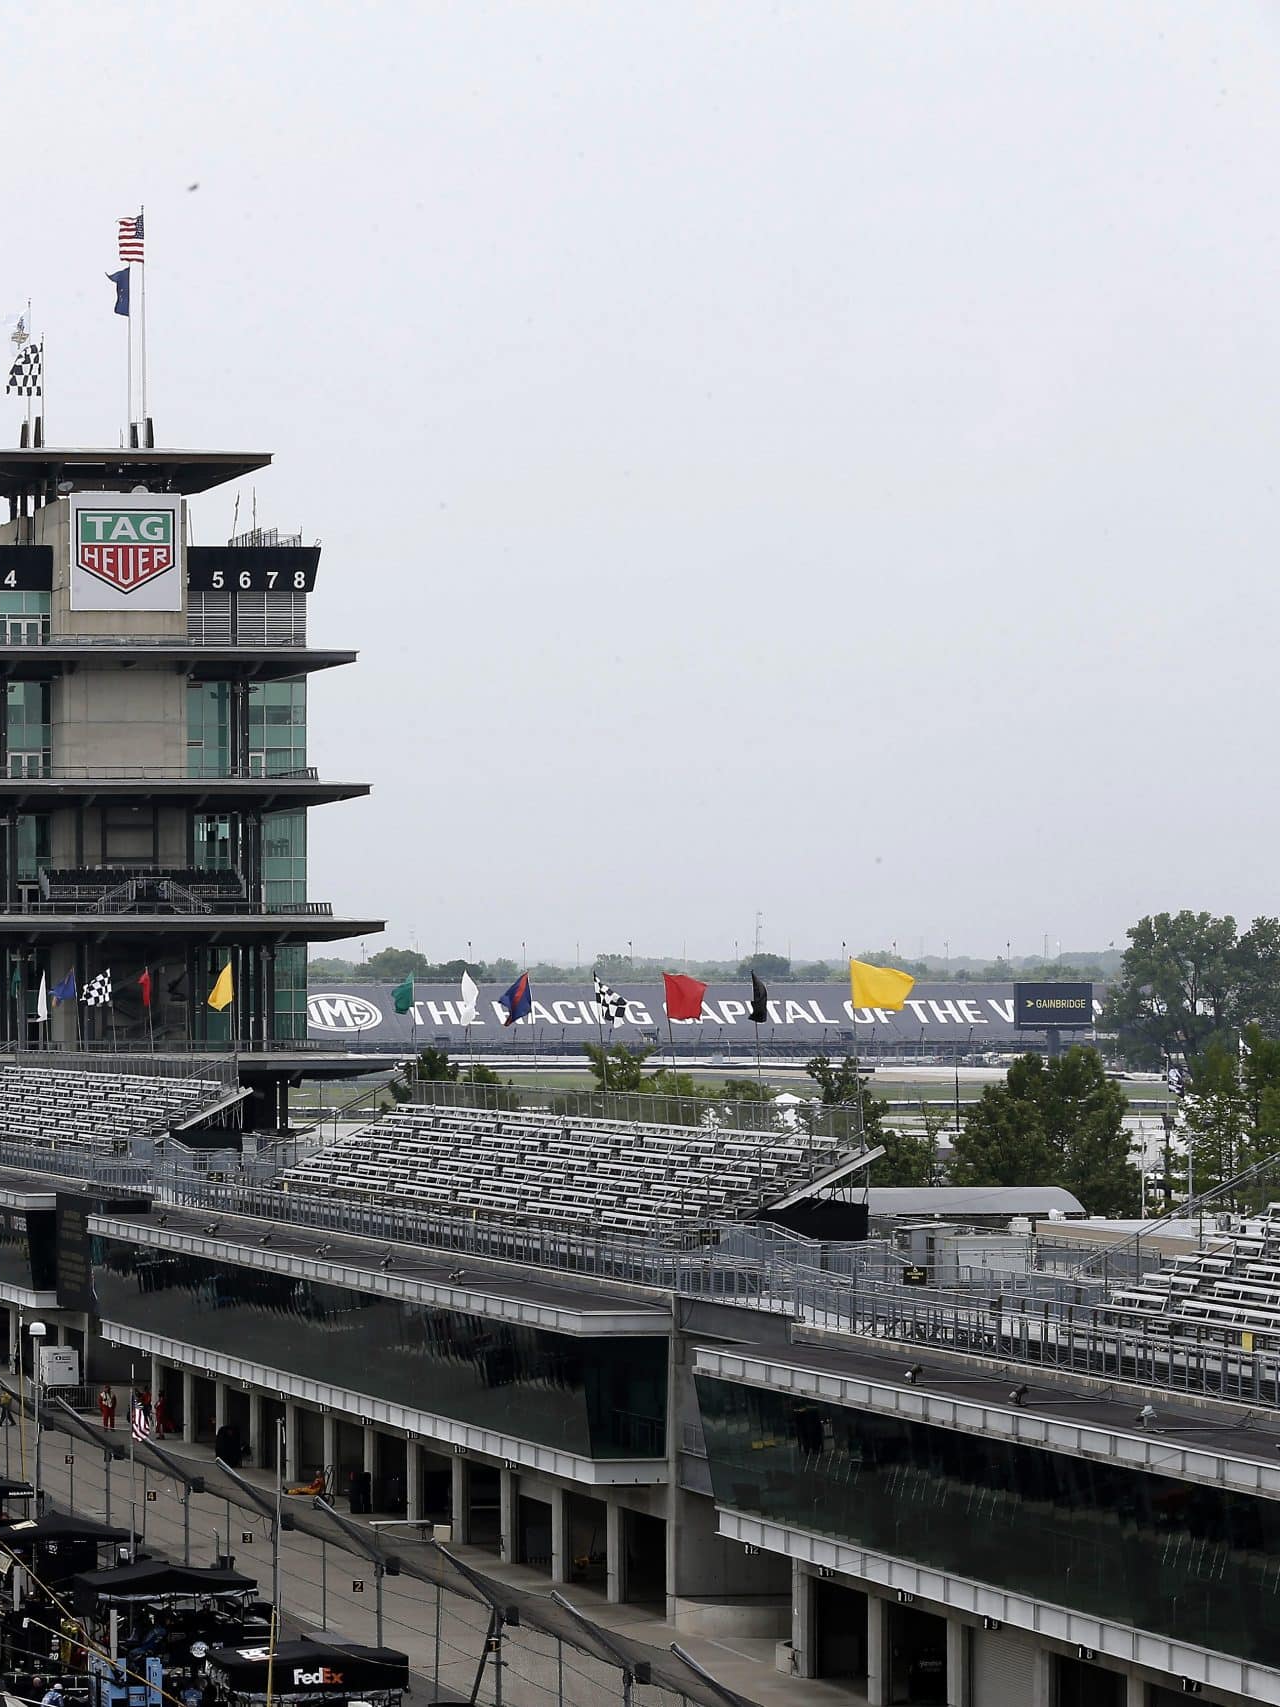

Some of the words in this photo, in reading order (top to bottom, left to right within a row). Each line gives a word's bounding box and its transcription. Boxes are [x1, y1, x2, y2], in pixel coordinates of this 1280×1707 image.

[87, 516, 164, 541] TAG
[84, 547, 167, 584] HEUER
[4, 569, 17, 587] 4
[212, 571, 225, 589] 5
[239, 571, 252, 589] 6
[266, 571, 279, 589] 7
[293, 571, 306, 589] 8
[307, 999, 372, 1027] IMS
[903, 999, 988, 1024] THE
[1035, 999, 1086, 1009] GAINBRIDGE
[293, 1667, 344, 1686] FedEx
